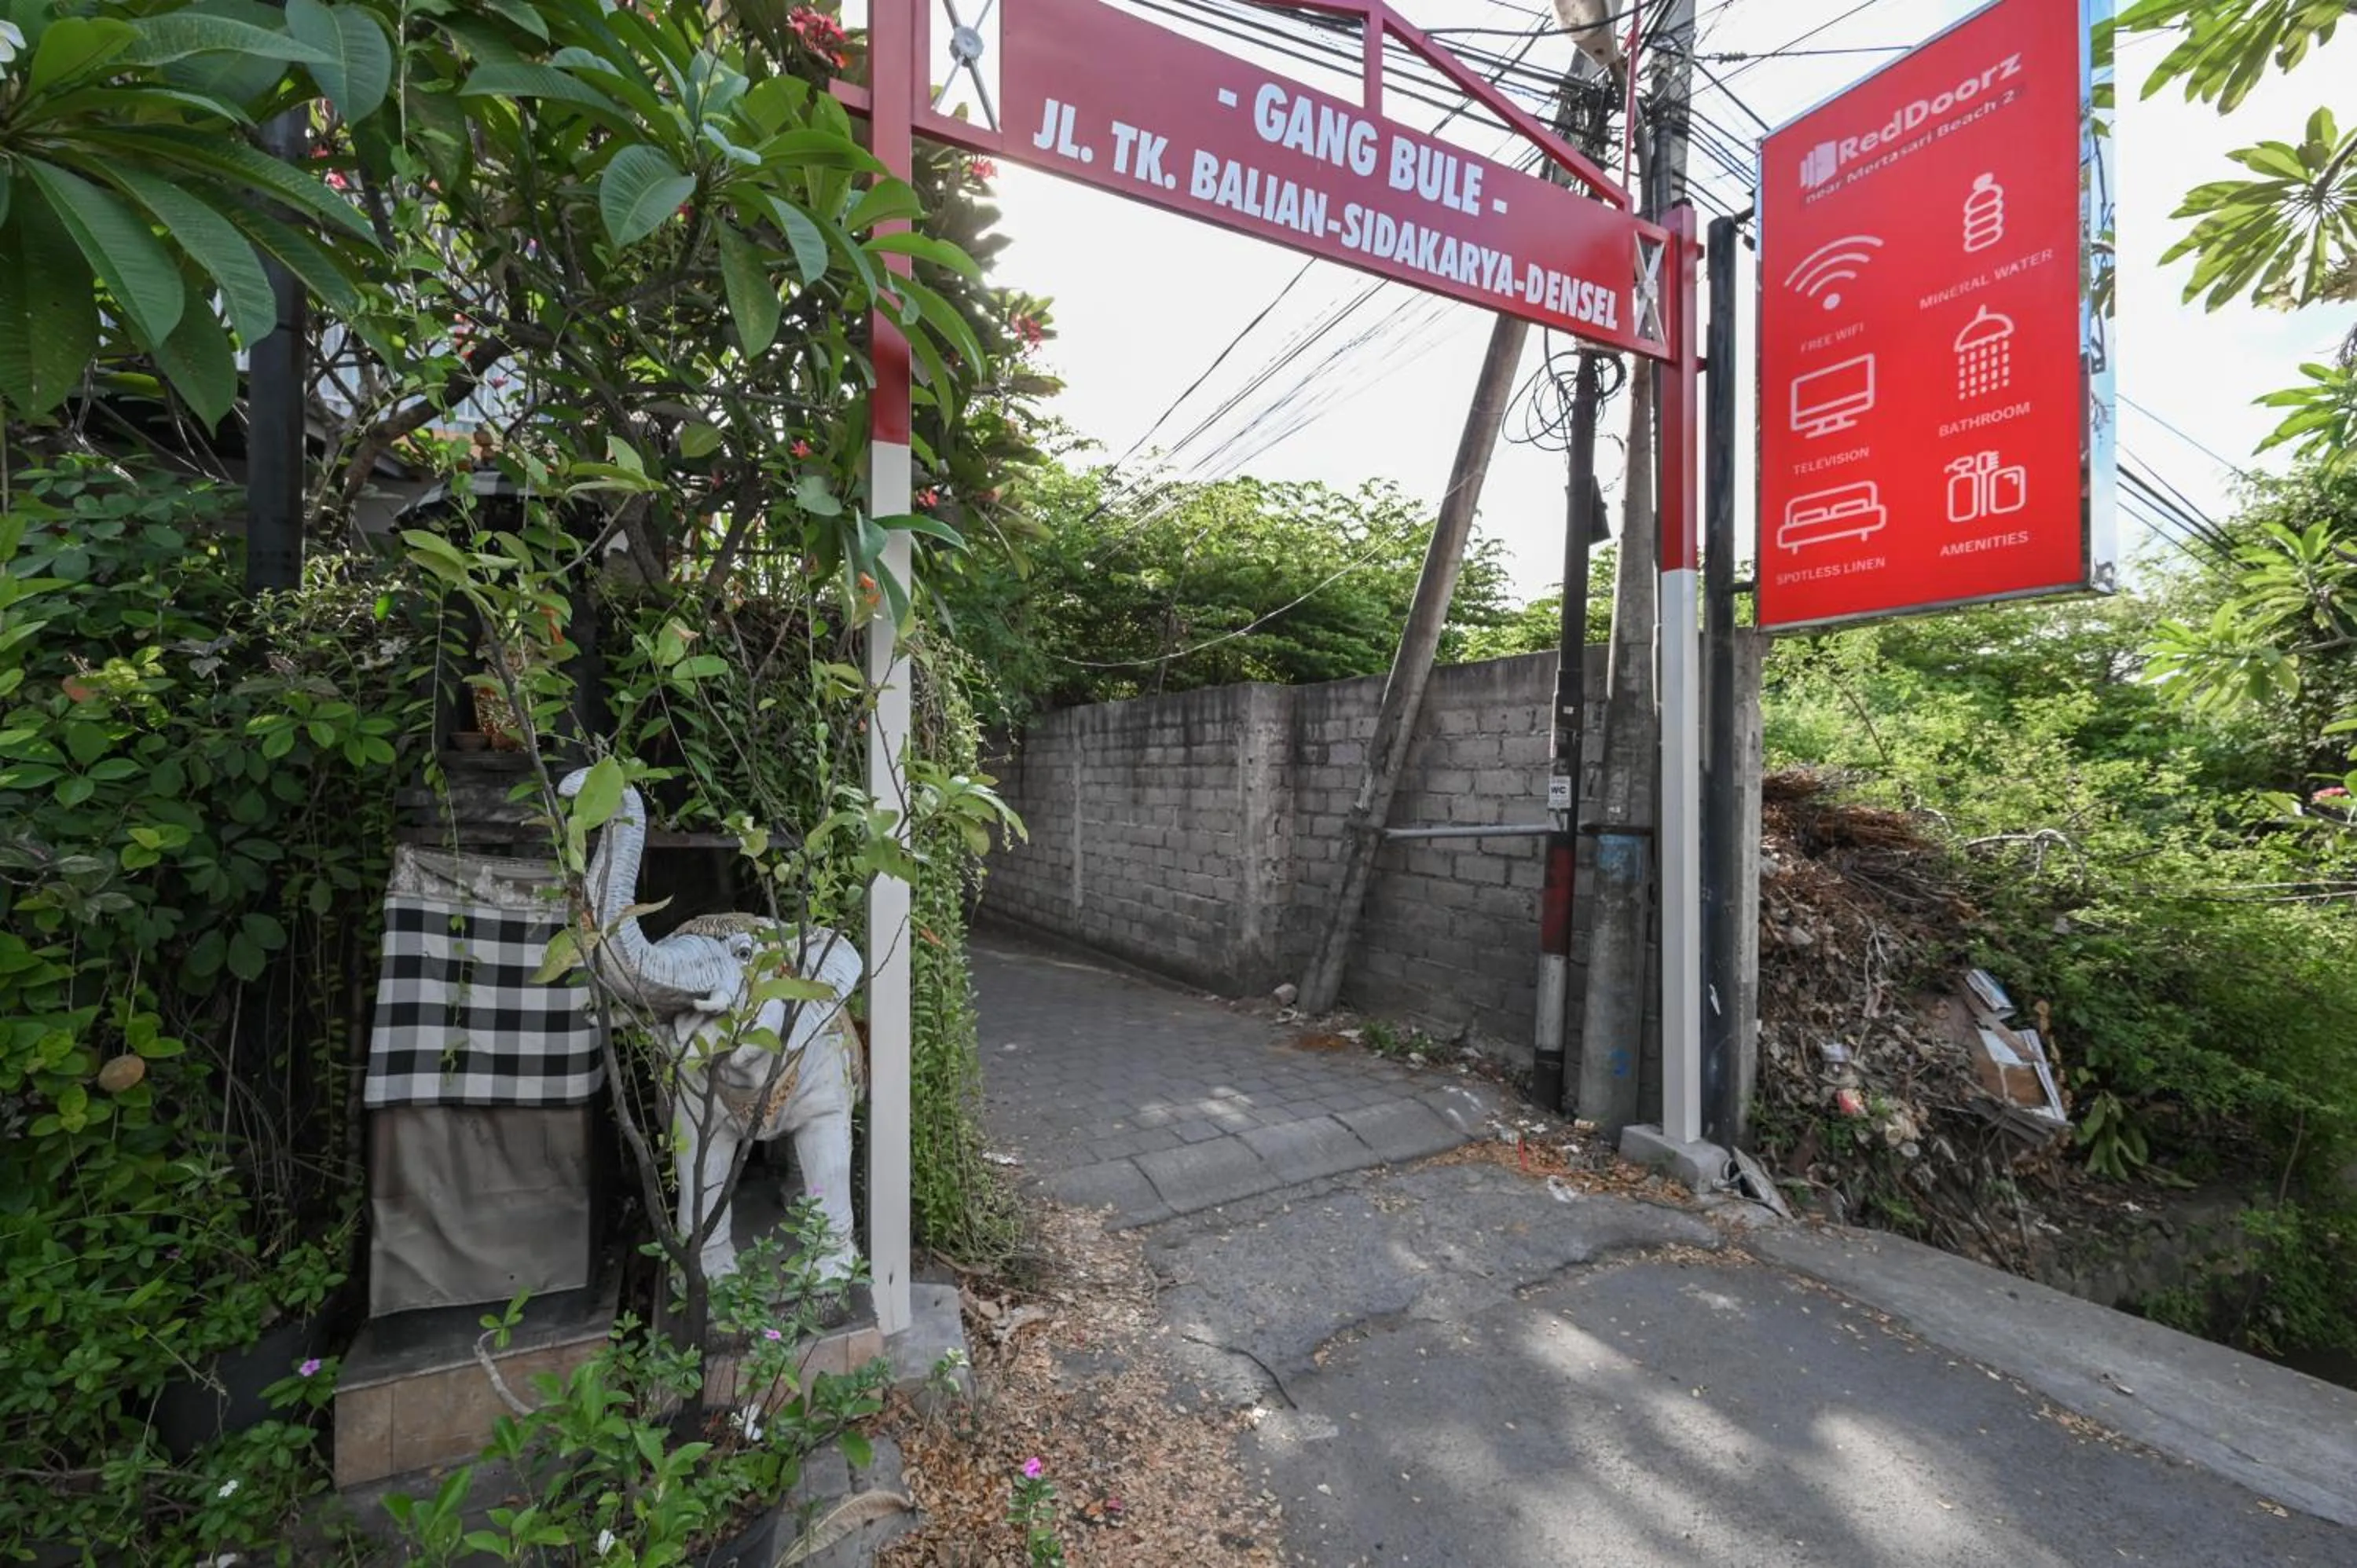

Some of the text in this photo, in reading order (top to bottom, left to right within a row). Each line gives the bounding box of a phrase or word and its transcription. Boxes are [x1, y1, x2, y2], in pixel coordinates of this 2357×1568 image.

[1838, 52, 2022, 165] RedDoorz
[1255, 82, 1378, 176] GANG
[1389, 134, 1483, 216] BULE
[1805, 181, 1842, 203] near
[1937, 101, 1996, 137] Beach
[2003, 89, 2015, 104] 2
[1033, 97, 1618, 331] JL. TK. BALIAN-SIDAKARYA-DENSEL
[1919, 248, 2054, 310] MINERAL WATER
[1800, 322, 1864, 353] FREE WIFI
[1938, 401, 2031, 438] BATHROOM
[1793, 446, 1870, 475] TELEVISION
[1940, 530, 2029, 557] AMENITIES
[1776, 556, 1886, 586] SPOTLESS LINEN
[1551, 786, 1567, 794] WC
